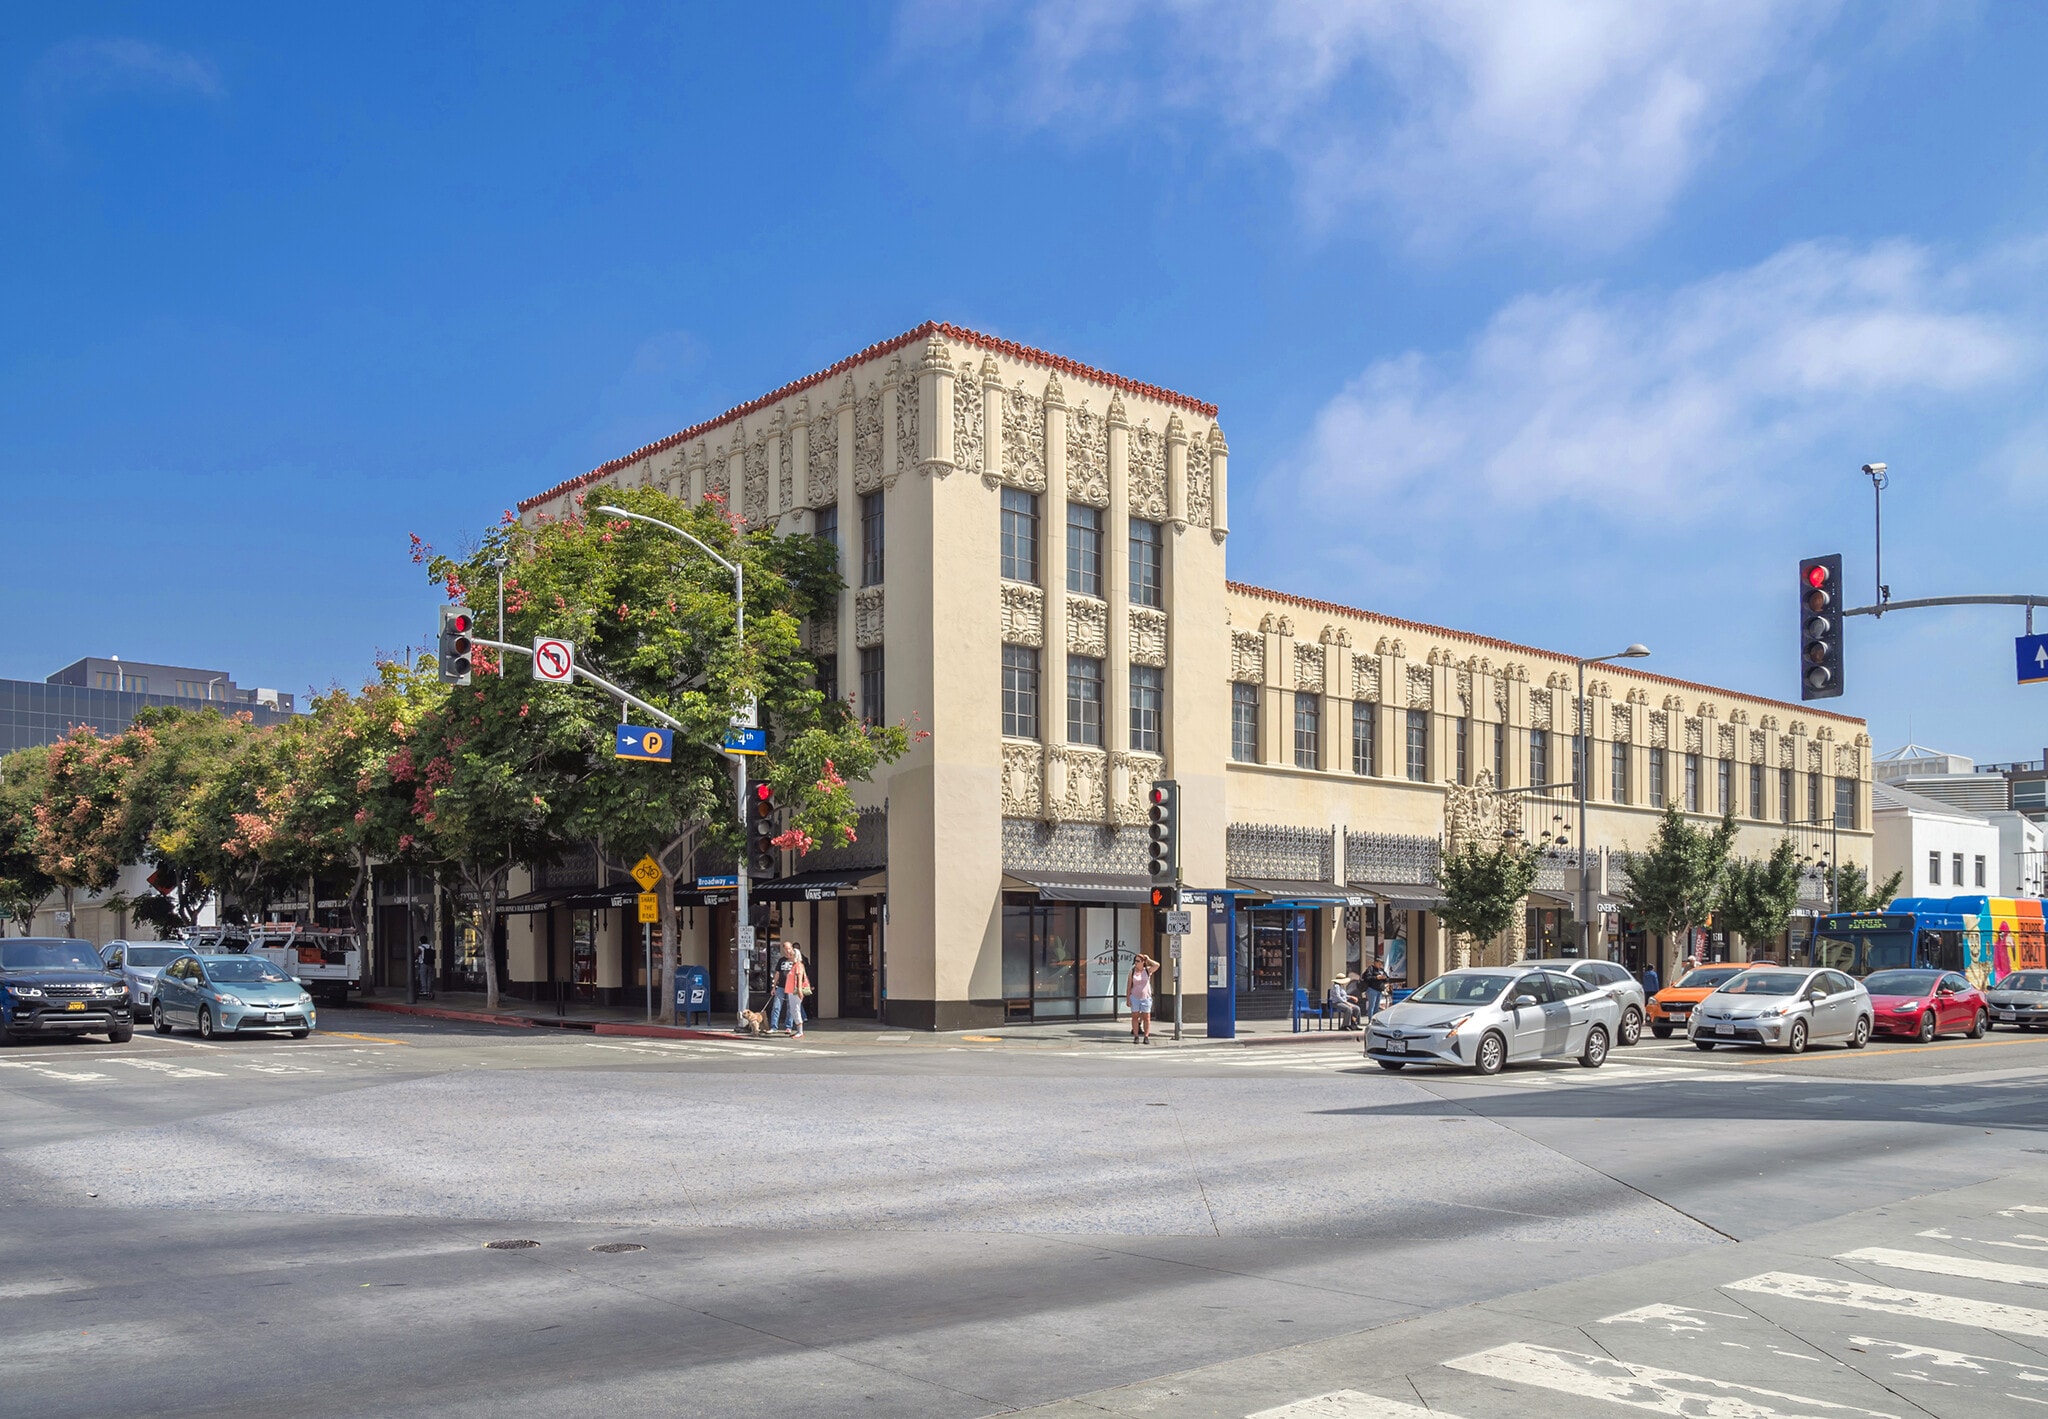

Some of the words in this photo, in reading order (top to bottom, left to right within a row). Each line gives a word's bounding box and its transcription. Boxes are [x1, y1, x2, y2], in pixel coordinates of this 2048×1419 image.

[649, 737, 658, 749] P
[698, 877, 726, 886] Broadway
[805, 889, 822, 900] VANS
[611, 897, 622, 907] VANS
[704, 895, 718, 905] VANS
[1168, 923, 1176, 932] OK
[1098, 954, 1133, 966] RAINOWS
